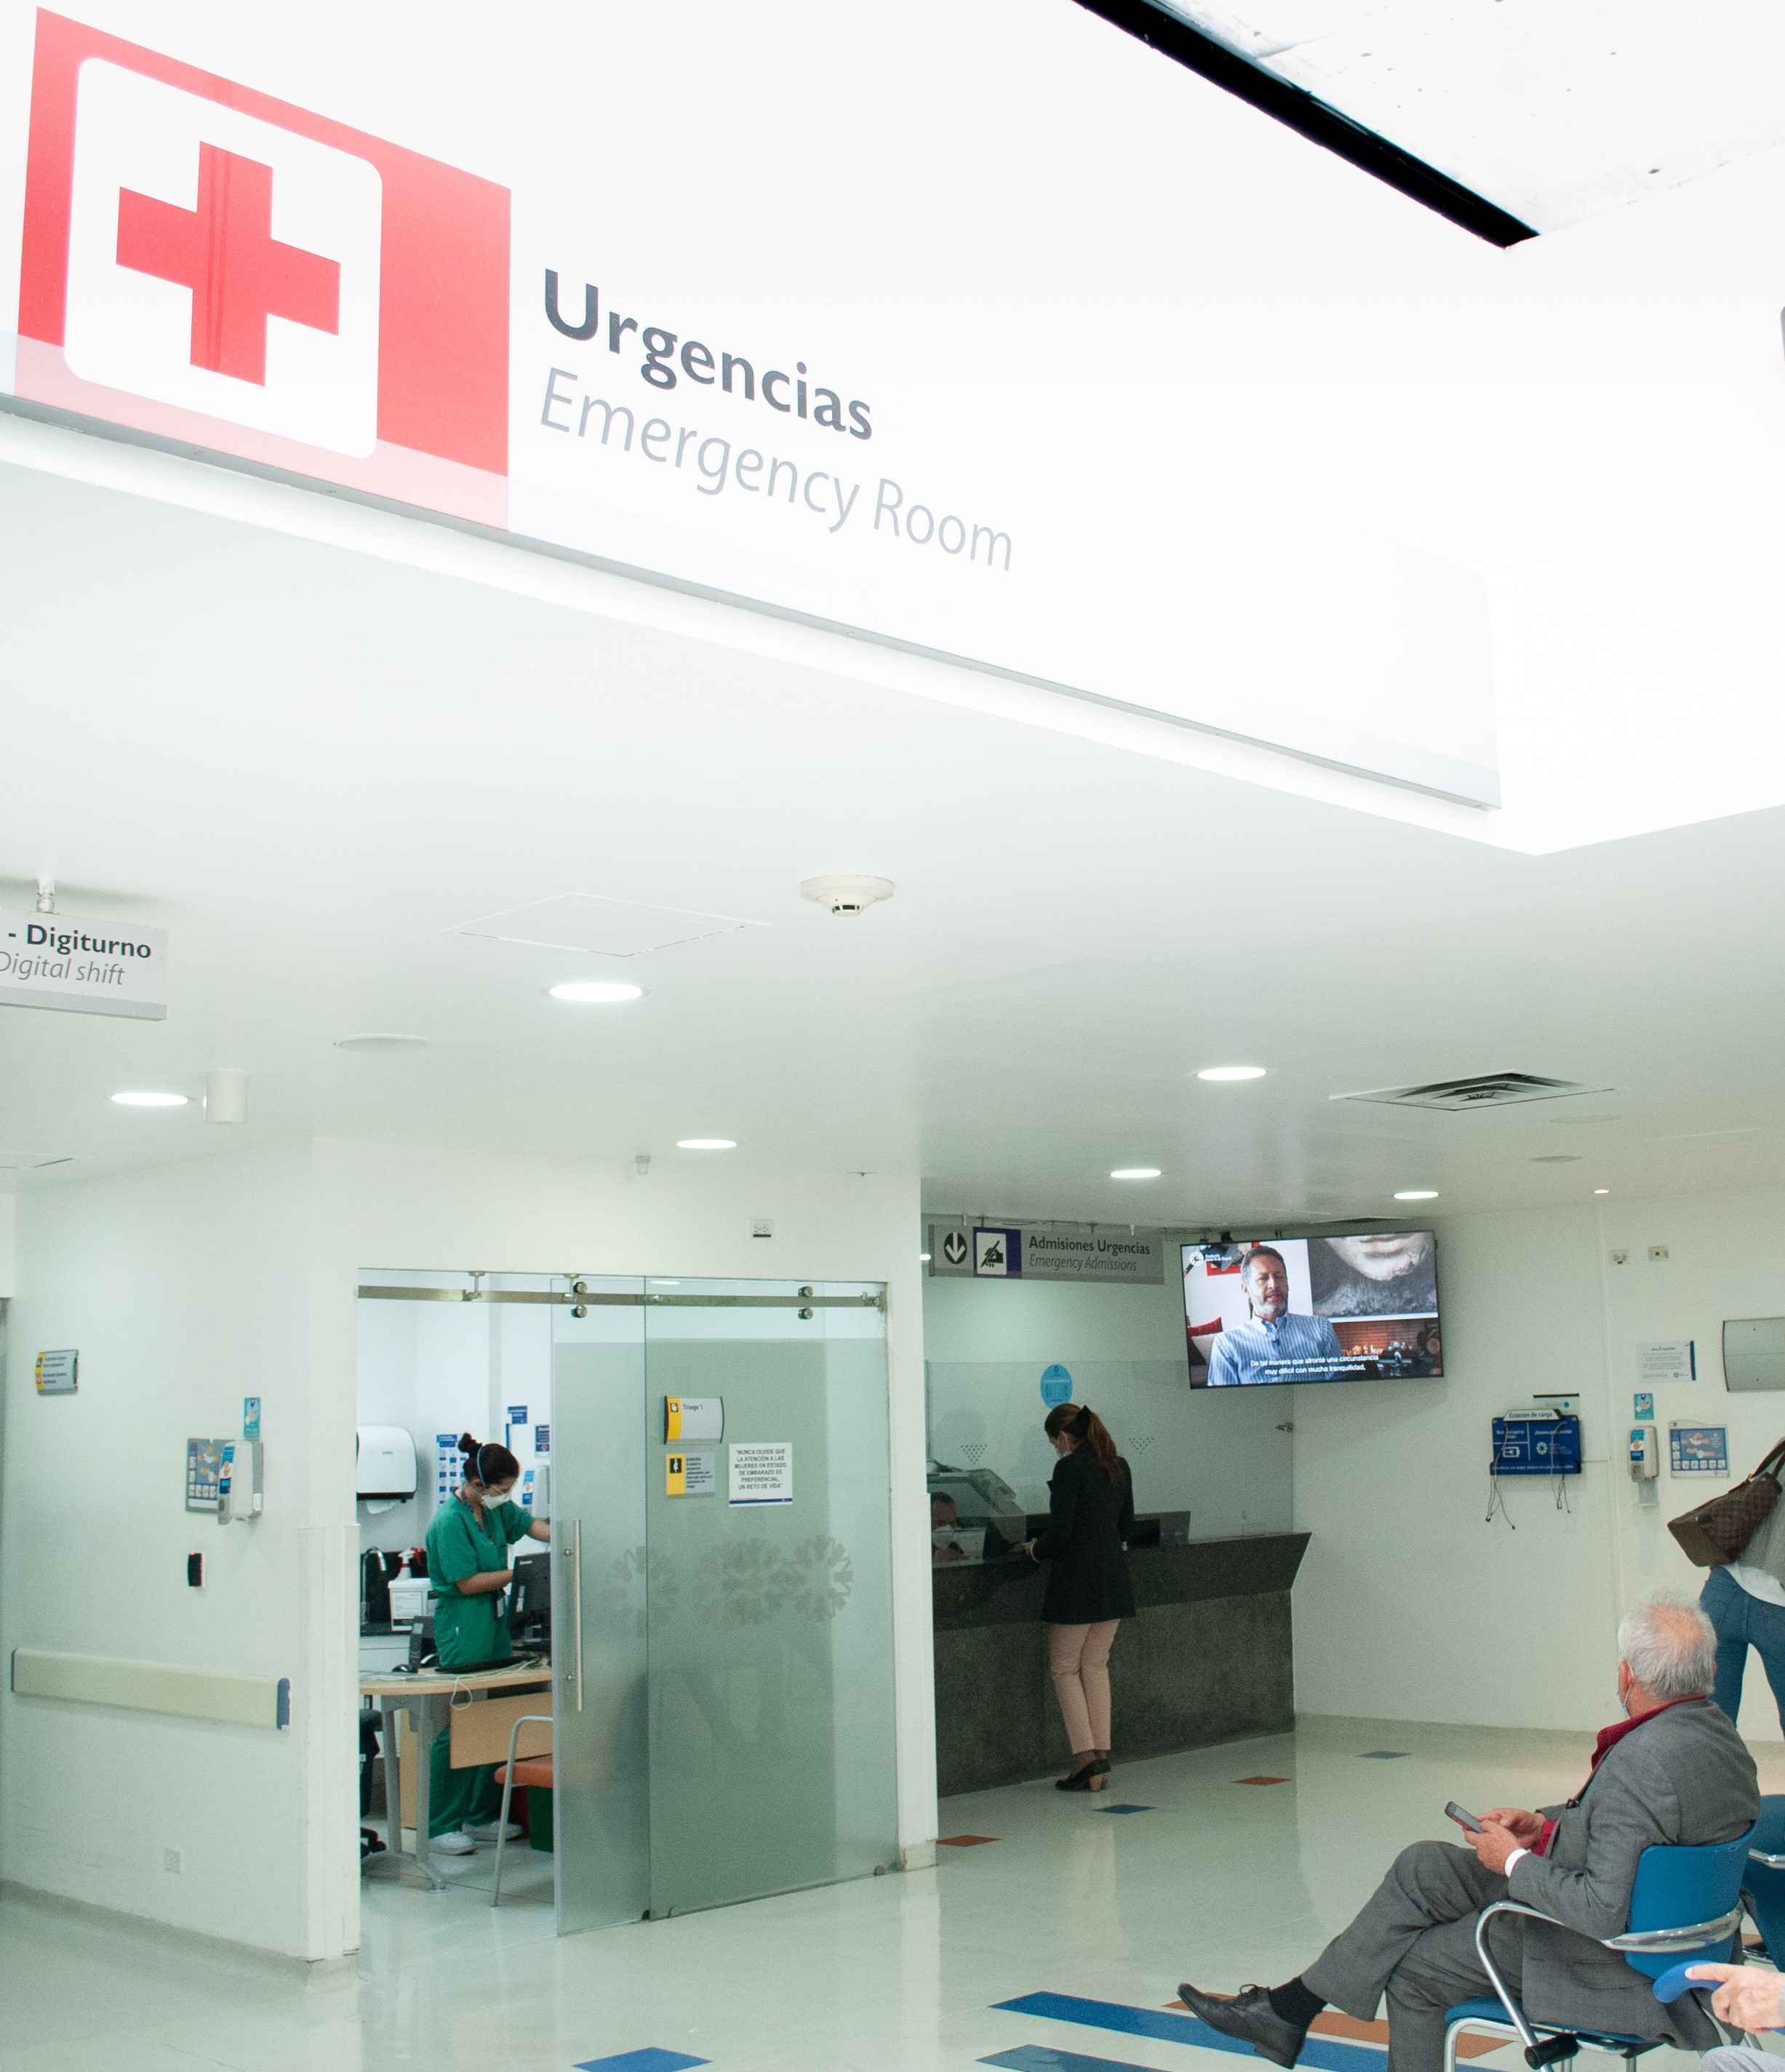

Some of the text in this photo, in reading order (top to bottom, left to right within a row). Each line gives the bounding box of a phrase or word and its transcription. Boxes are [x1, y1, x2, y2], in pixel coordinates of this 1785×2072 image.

[545, 268, 873, 439] Urgencias
[540, 367, 1012, 571] Emergency Room
[27, 924, 151, 958] Digiturno
[76, 961, 125, 985] shift
[1029, 1236, 1151, 1256] Admisiones Urgencias
[1029, 1254, 1137, 1272] Emergency Admissions
